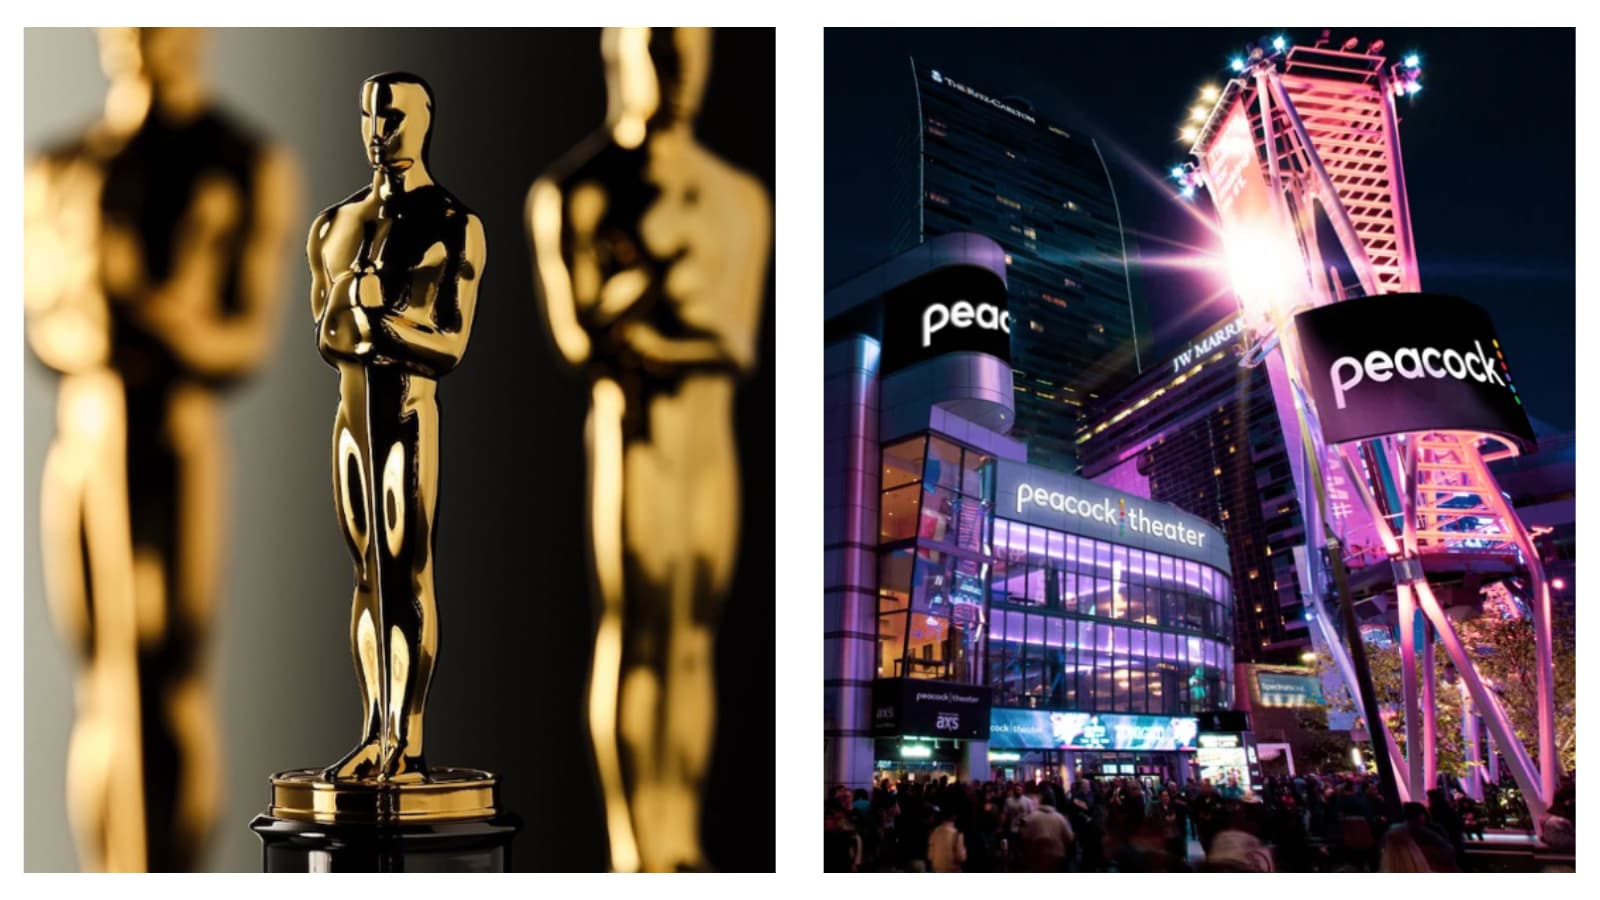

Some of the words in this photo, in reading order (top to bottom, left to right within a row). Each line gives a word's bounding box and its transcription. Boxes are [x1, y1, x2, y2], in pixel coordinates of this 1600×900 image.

[1173, 348, 1192, 373] JW
[1329, 339, 1506, 410] peacock
[1016, 483, 1118, 527] peacock
[1128, 508, 1206, 547] theater
[916, 691, 949, 703] peacock
[952, 694, 978, 703] theater
[936, 715, 959, 731] axs
